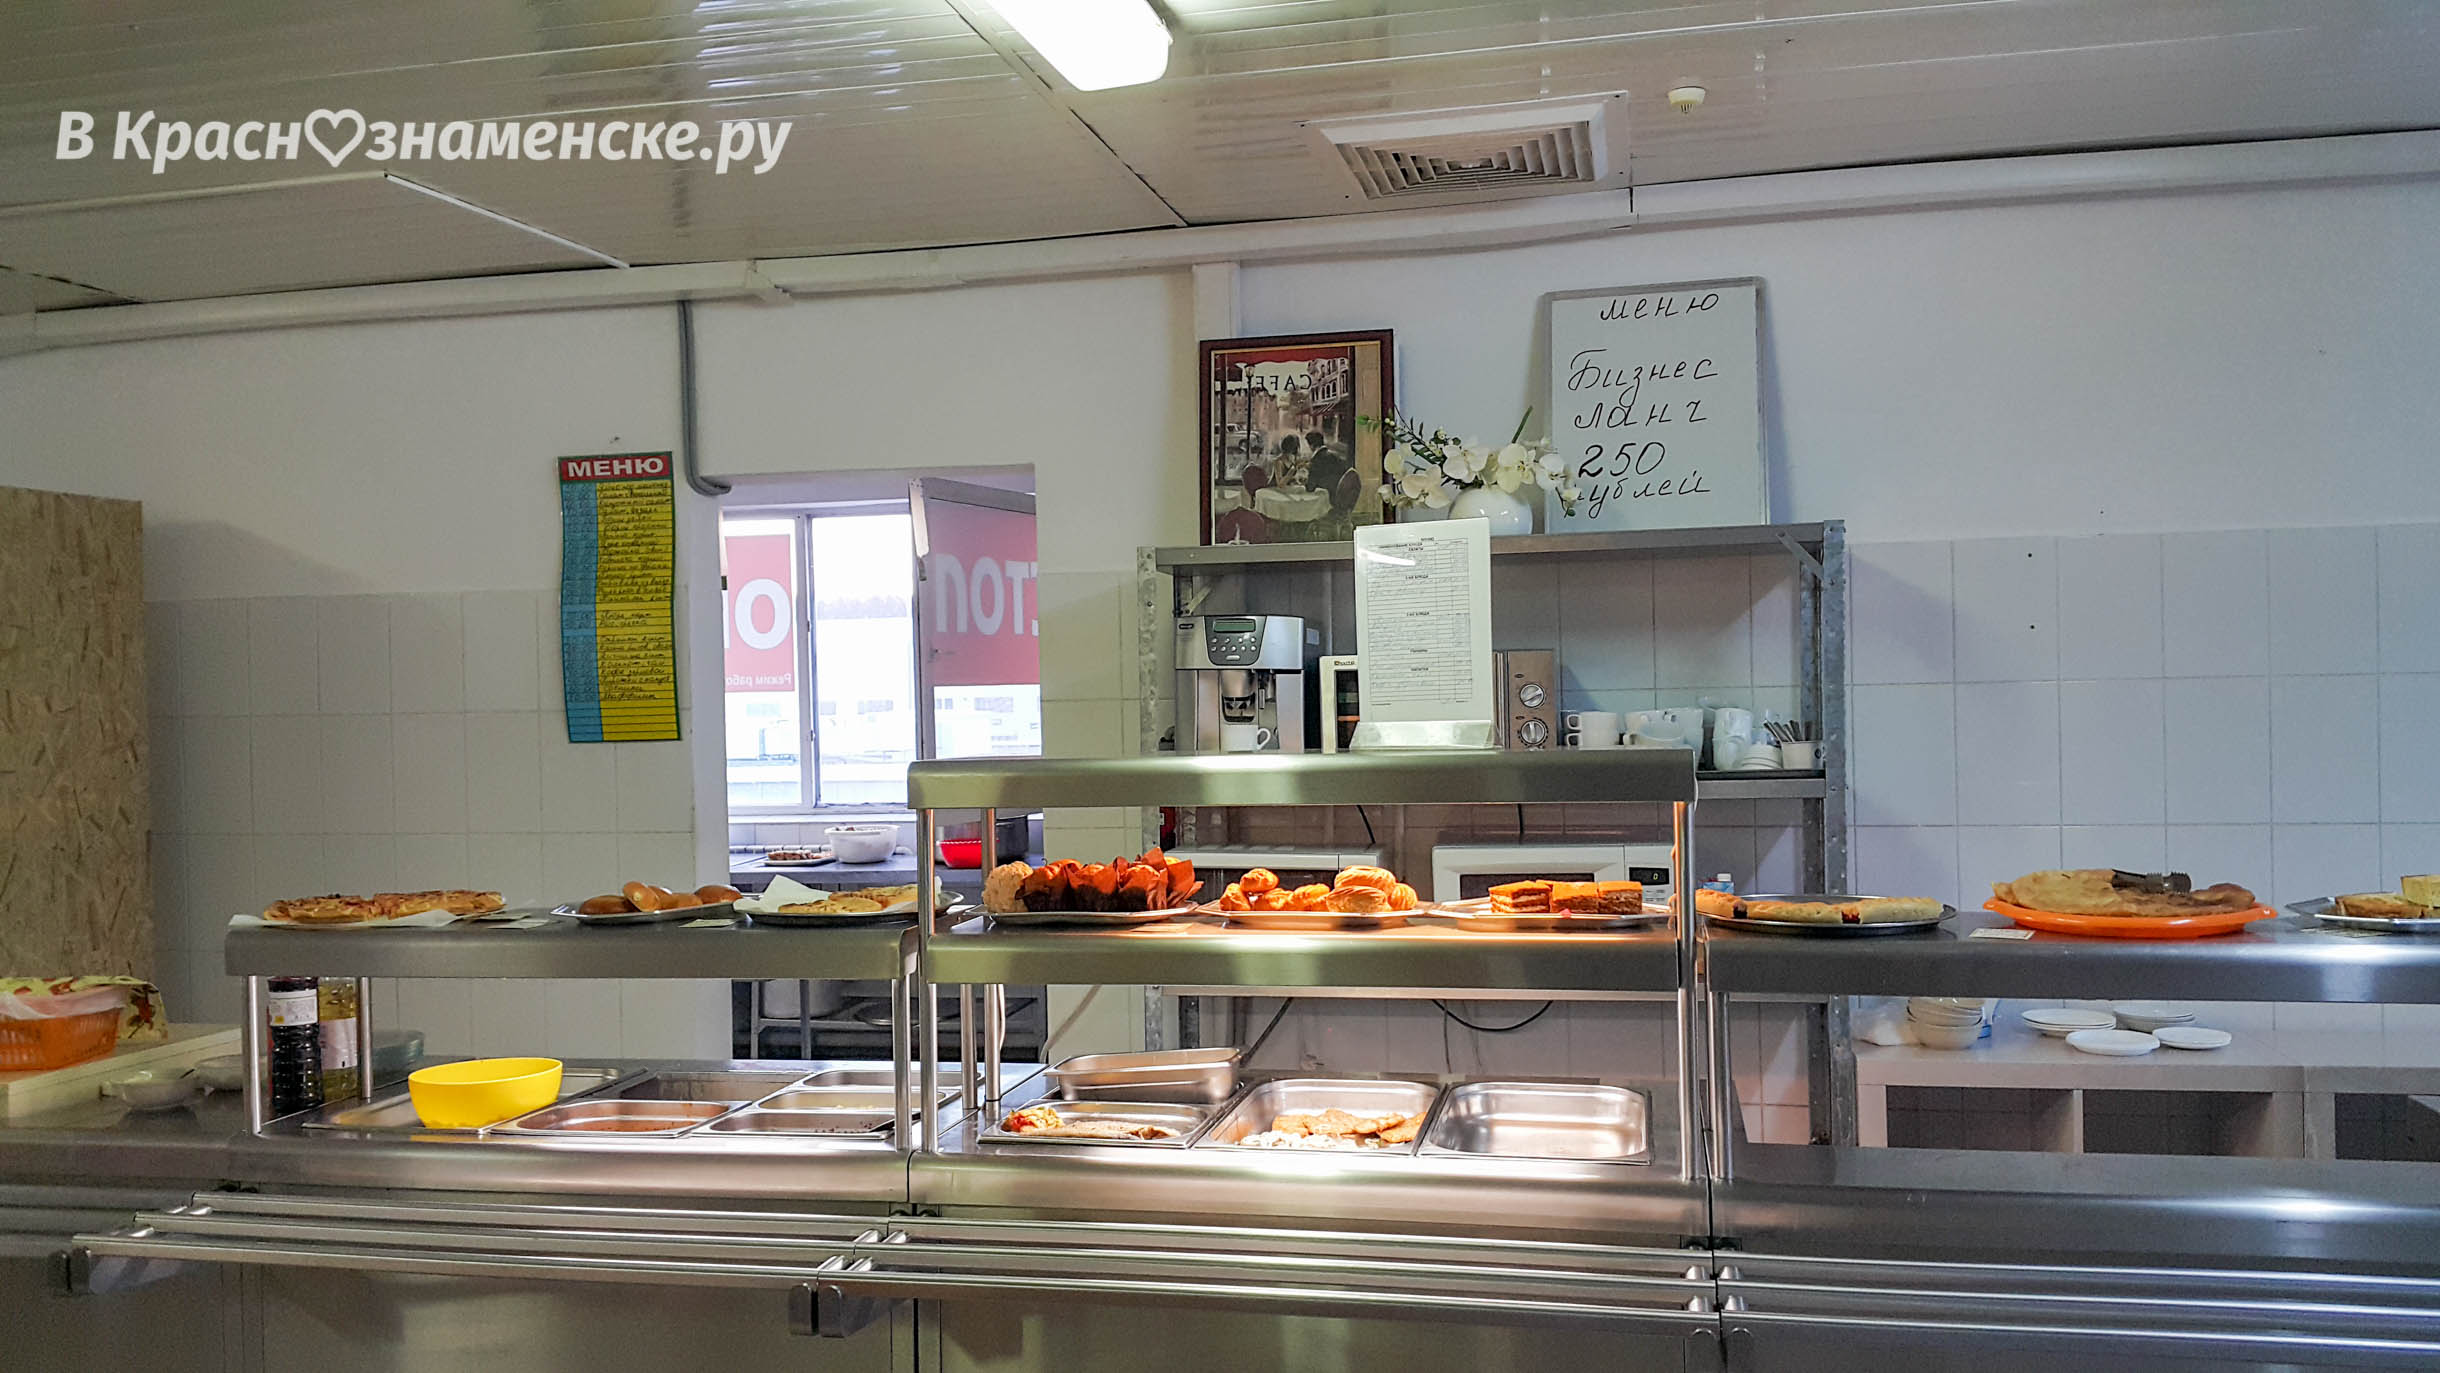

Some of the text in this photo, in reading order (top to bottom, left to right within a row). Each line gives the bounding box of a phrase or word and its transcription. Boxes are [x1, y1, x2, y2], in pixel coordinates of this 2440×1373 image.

[1568, 349, 1718, 407] Бизнес
[567, 457, 664, 477] МЕНЮ
[1578, 441, 1666, 478] 250
[1578, 470, 1711, 519] ублей
